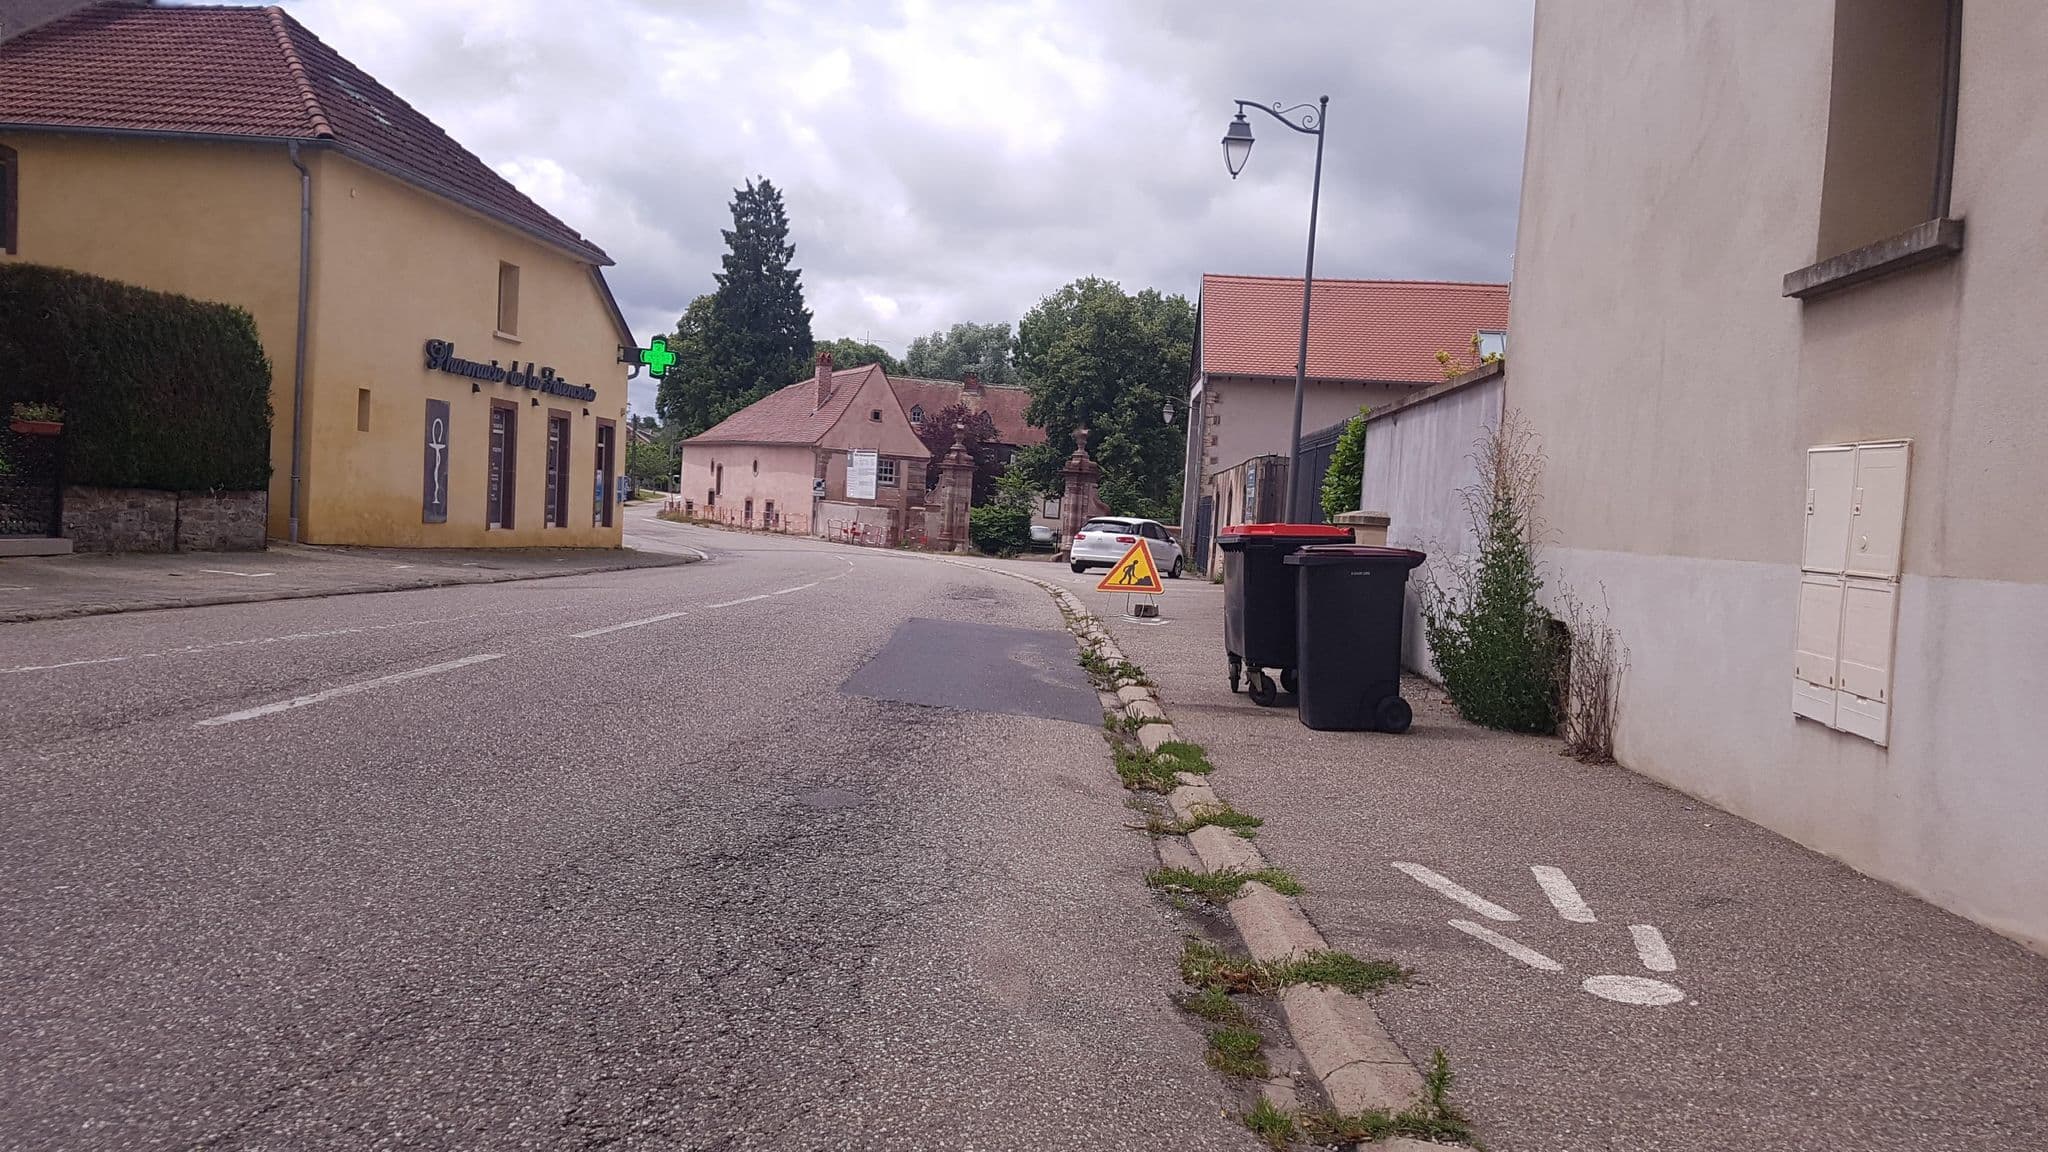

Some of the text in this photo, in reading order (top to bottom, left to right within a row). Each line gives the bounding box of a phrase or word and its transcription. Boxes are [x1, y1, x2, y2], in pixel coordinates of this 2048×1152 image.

[426, 339, 506, 382] Pharmacie
[506, 361, 523, 386] de
[525, 363, 541, 390] la
